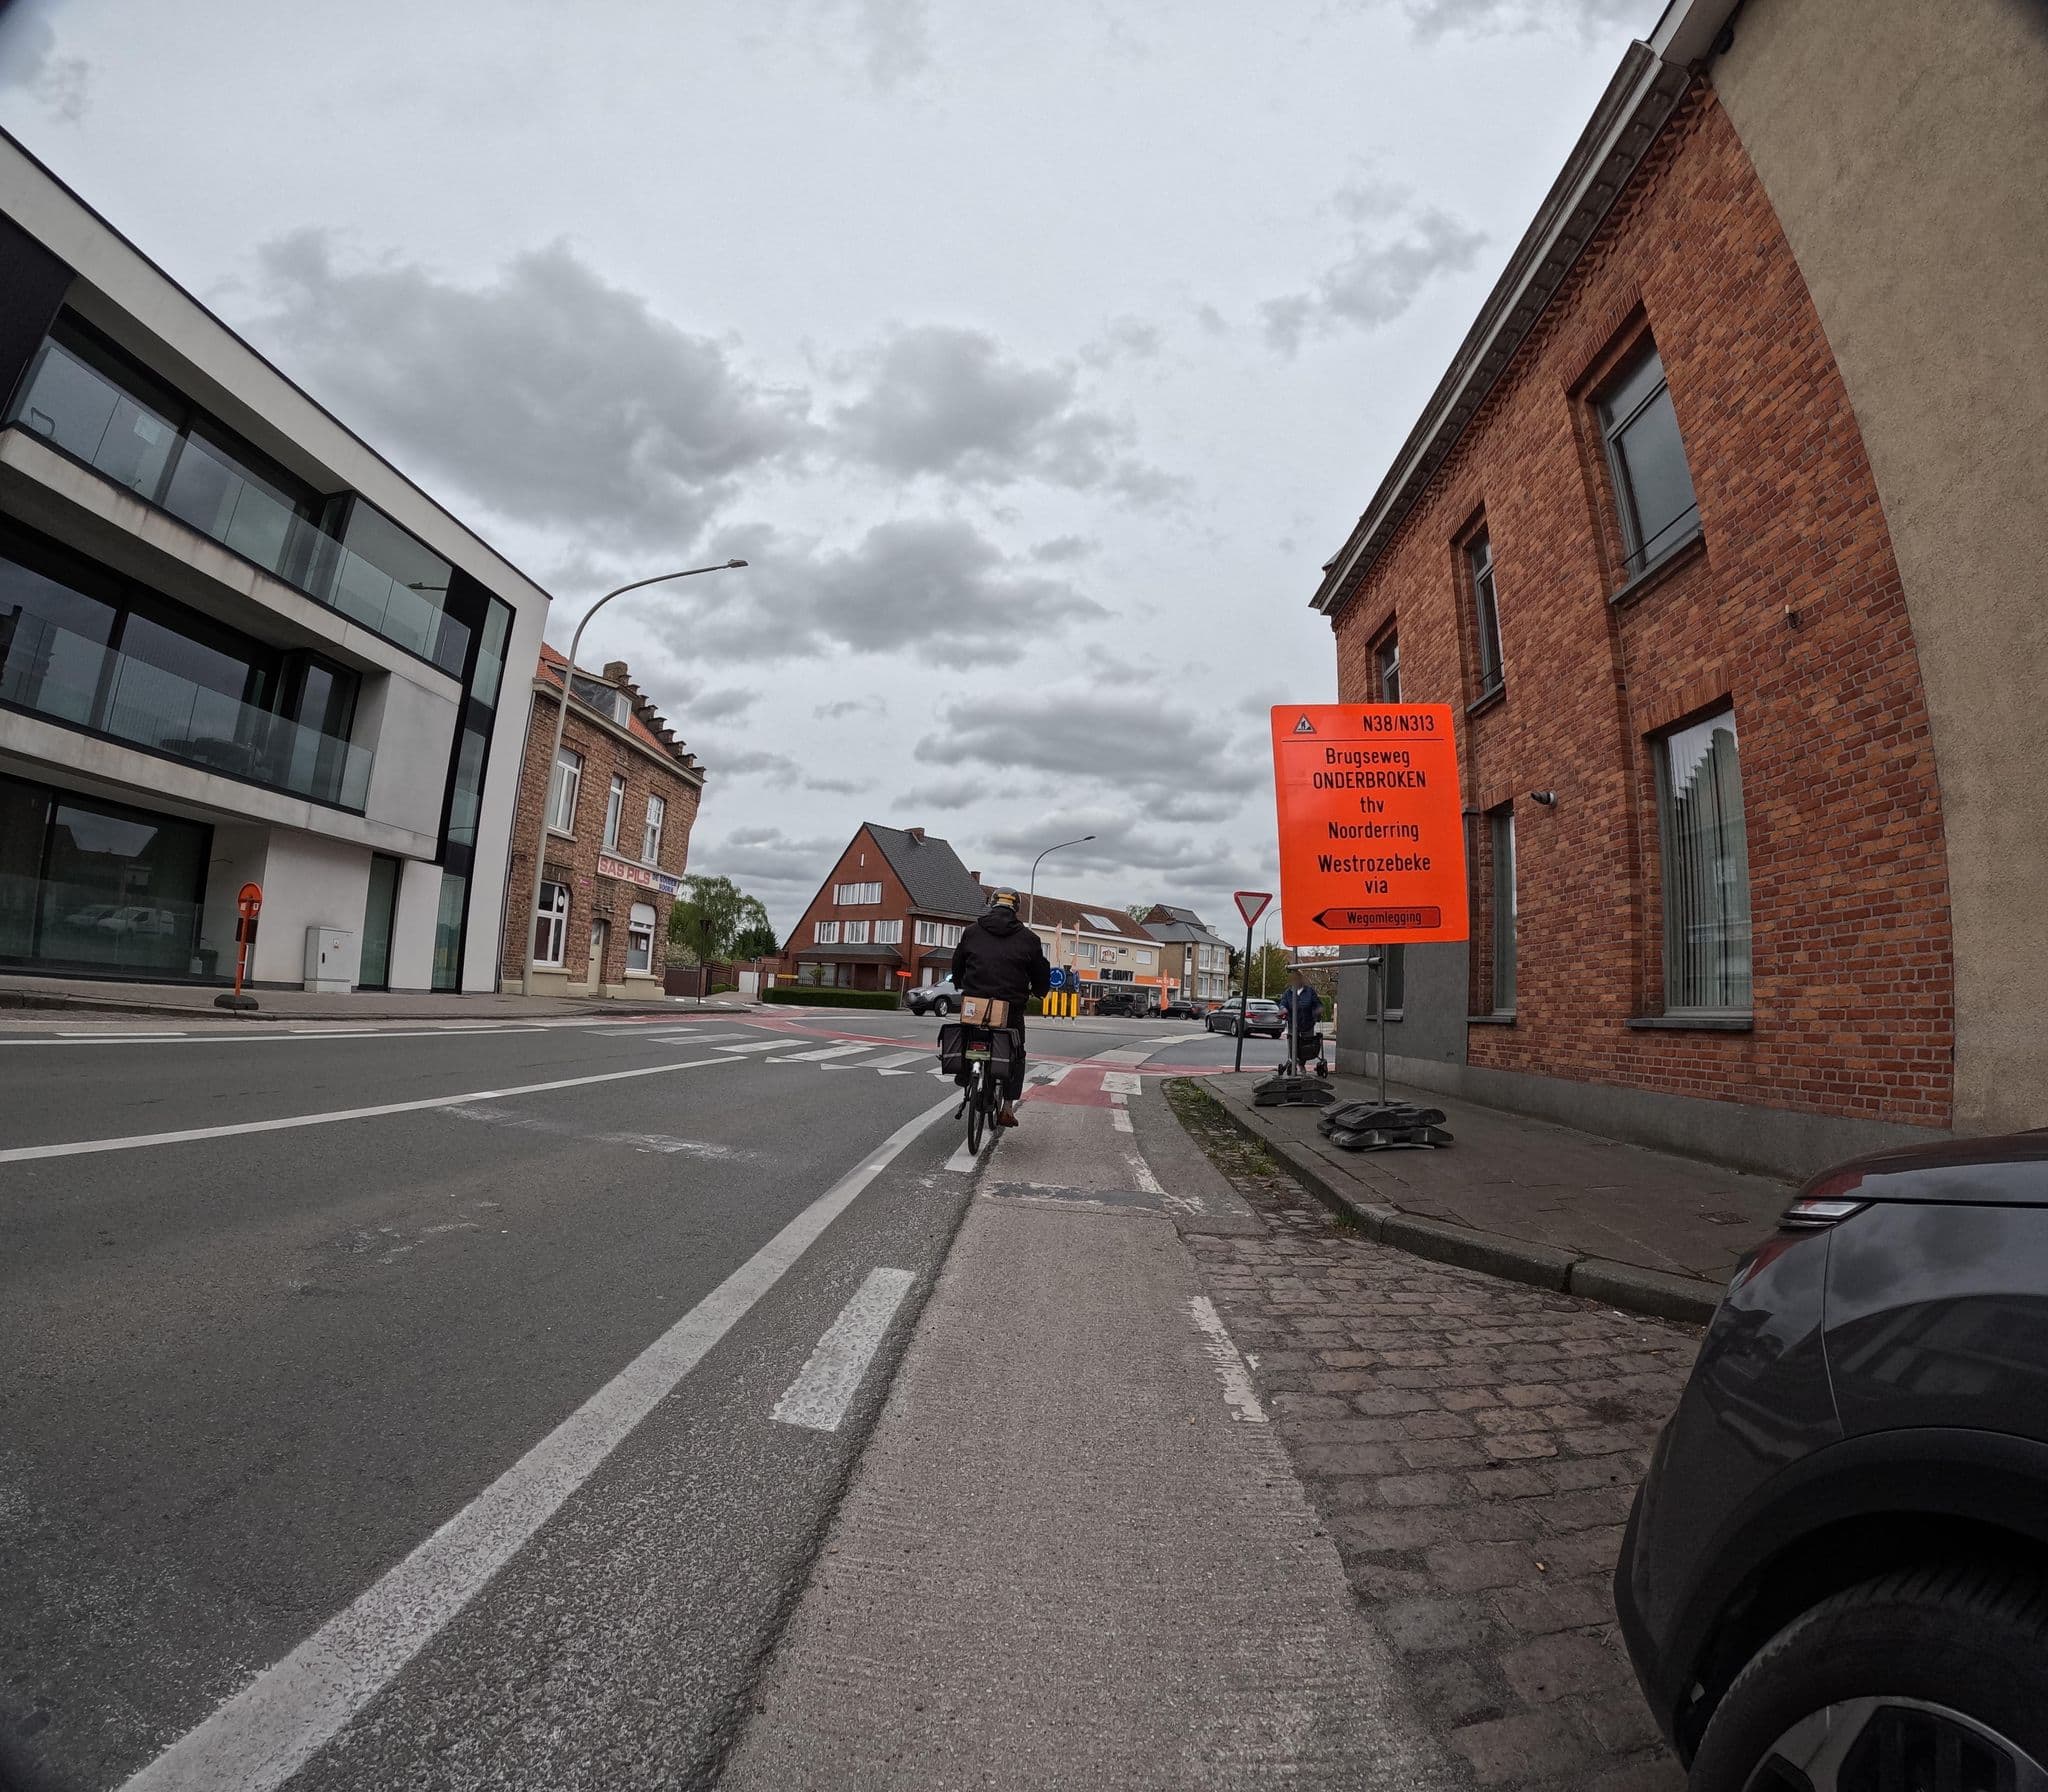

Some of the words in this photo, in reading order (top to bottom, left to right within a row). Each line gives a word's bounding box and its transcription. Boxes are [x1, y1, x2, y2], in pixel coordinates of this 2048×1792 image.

[1363, 715, 1435, 732] N38/N313
[1325, 748, 1410, 768] Brugseweg
[1313, 771, 1426, 789] ONDERBROKEN
[1360, 796, 1384, 813] thv
[1328, 821, 1419, 841] Noorderring
[1318, 853, 1431, 872] Westrozebeke
[626, 866, 651, 885] PILS
[1365, 876, 1388, 893] via
[1347, 911, 1421, 927] Wegomlegging
